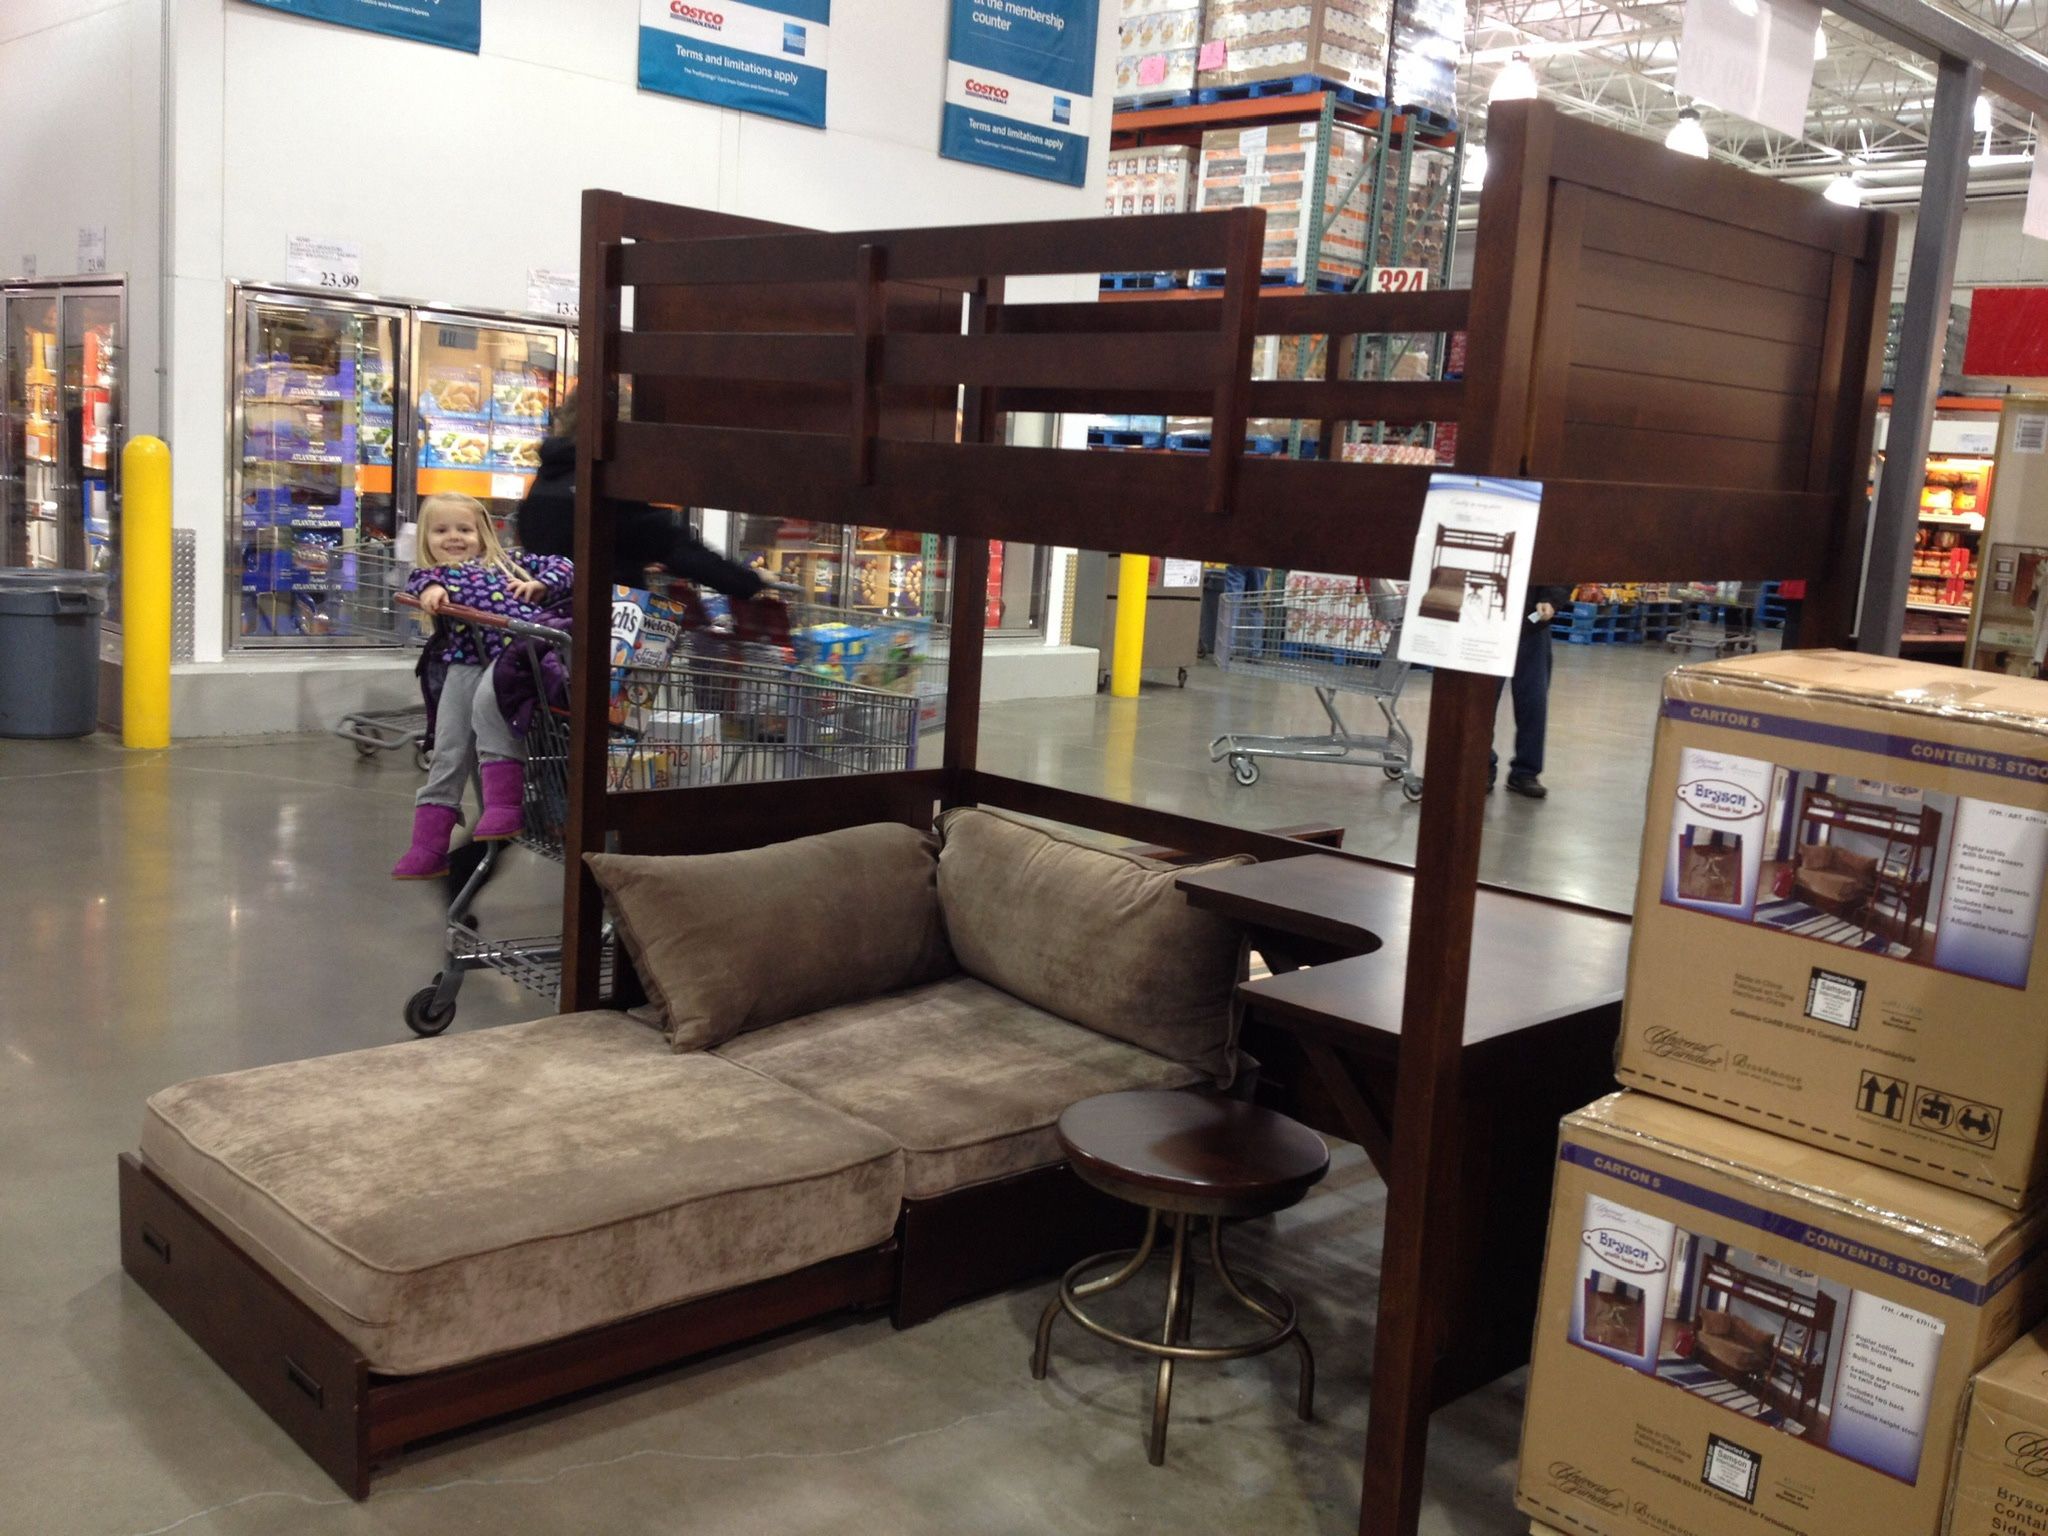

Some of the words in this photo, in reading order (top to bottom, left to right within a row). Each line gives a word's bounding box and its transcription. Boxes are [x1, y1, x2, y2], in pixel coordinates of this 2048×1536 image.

[670, 0, 724, 25] COSTCO
[972, 11, 1012, 31] counter
[1004, 2, 1065, 31] membership
[675, 44, 703, 61] Terms
[705, 54, 723, 66] and
[724, 56, 773, 78] limitations
[773, 70, 799, 86] apply
[965, 79, 1009, 99] COSTCO
[969, 118, 991, 132] Terms
[992, 125, 1006, 136] and
[1007, 127, 1044, 146] limitations
[1044, 136, 1064, 151] apply
[320, 271, 359, 288] 23.99
[643, 615, 677, 636] Welch's
[1690, 707, 1749, 727] CARTON
[1751, 718, 1760, 728] 5
[1911, 744, 2003, 771] CONTENTS:
[1695, 783, 1747, 807] Bryson
[1820, 980, 1852, 997] Samson
[1594, 1157, 1650, 1184] CARTON
[1652, 1177, 1661, 1188] 5
[1599, 1231, 1649, 1261] Bryson
[1805, 1229, 1894, 1270] CONTENTS:
[1897, 1262, 1952, 1290] STOOL
[1717, 1450, 1748, 1469] Samson
